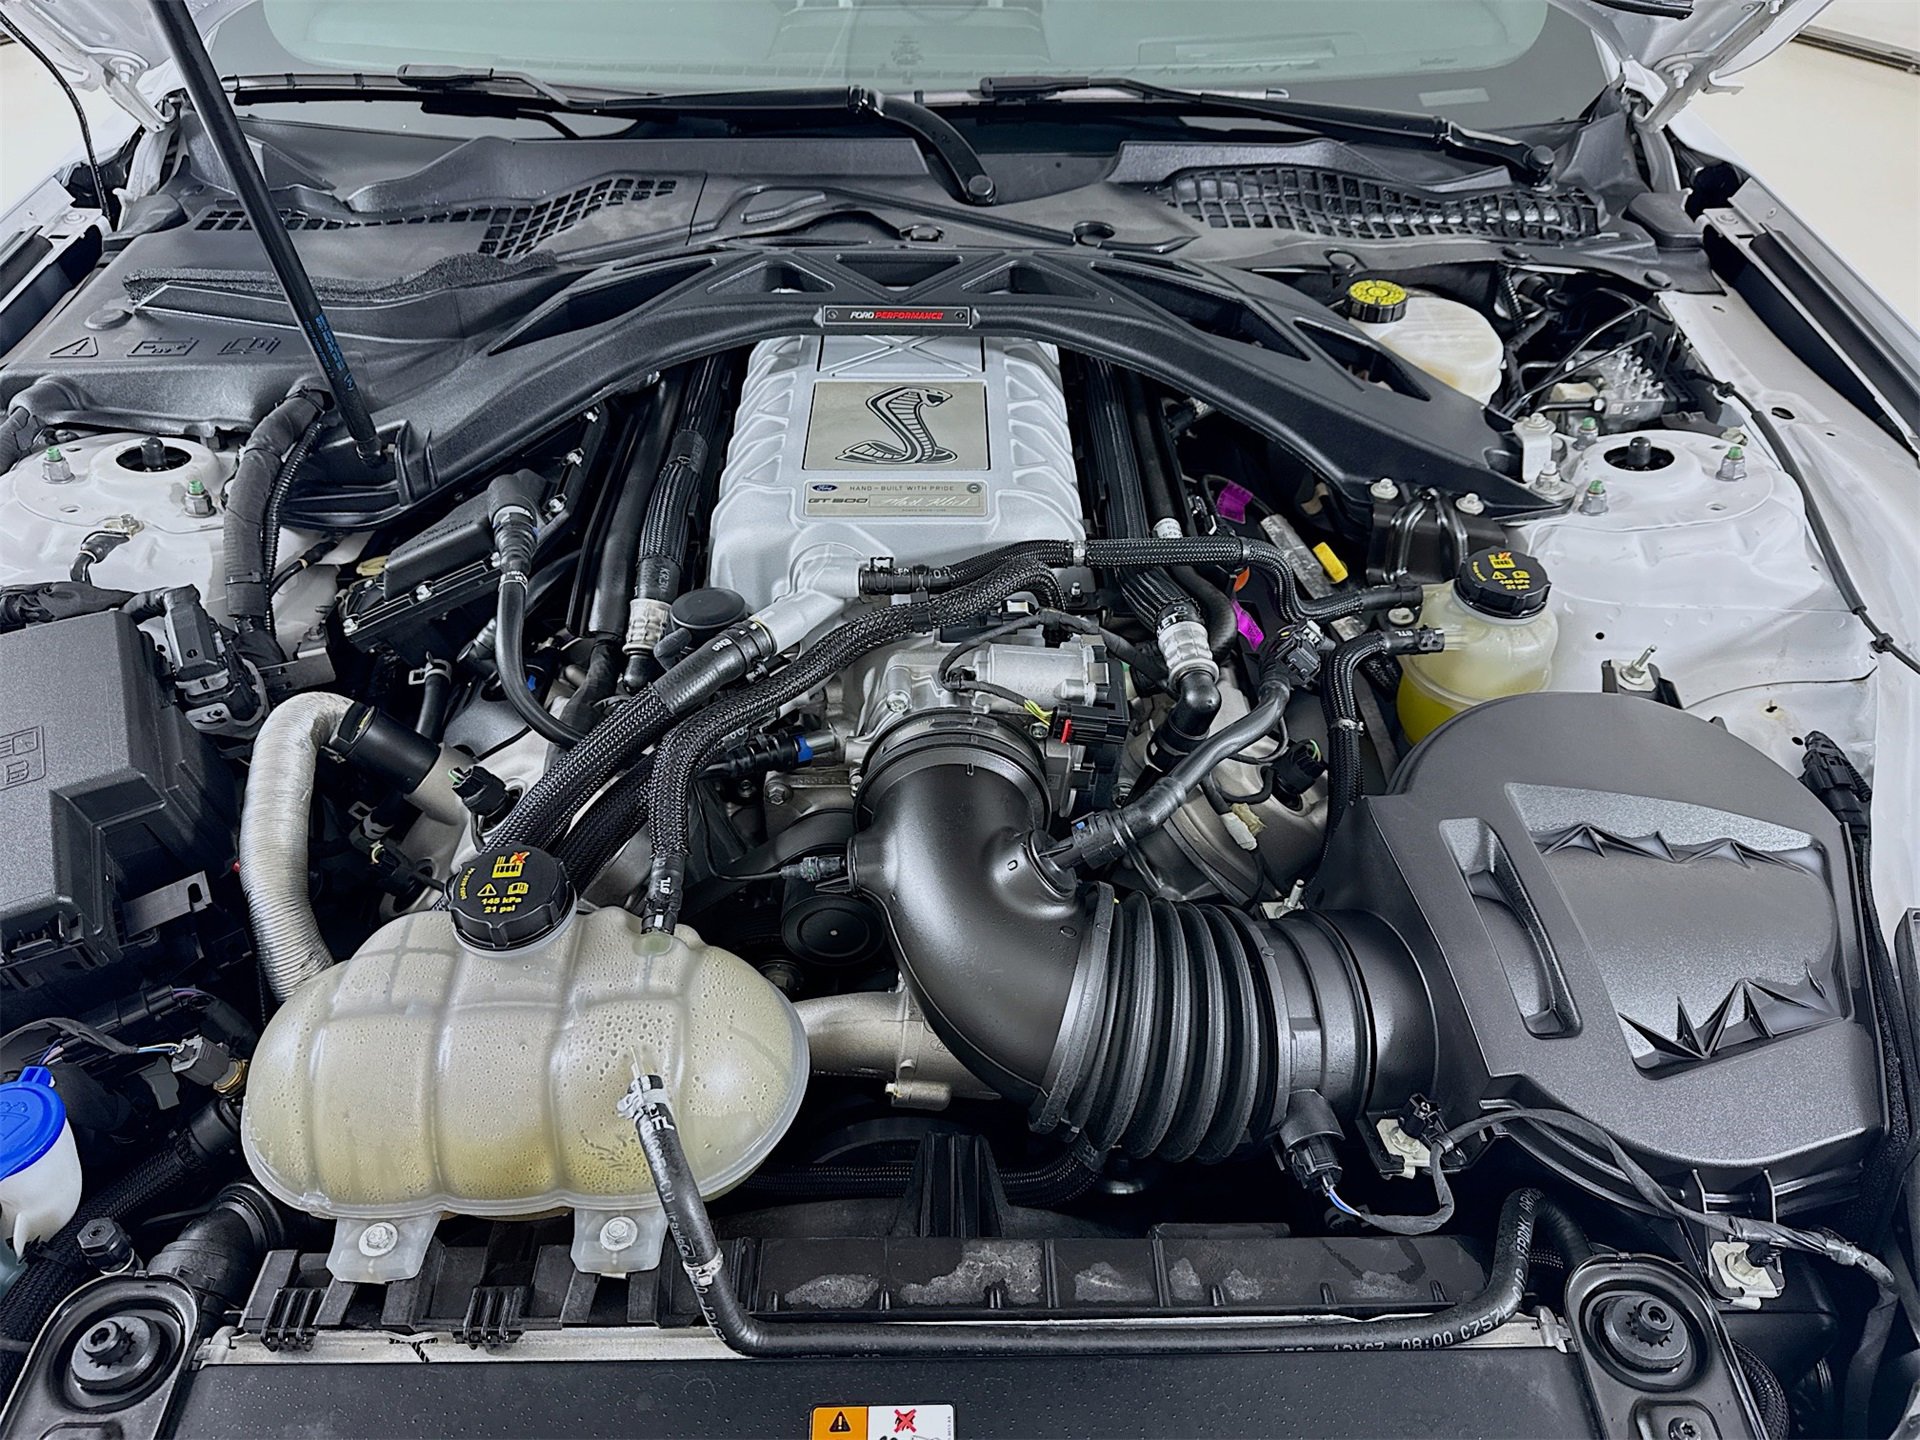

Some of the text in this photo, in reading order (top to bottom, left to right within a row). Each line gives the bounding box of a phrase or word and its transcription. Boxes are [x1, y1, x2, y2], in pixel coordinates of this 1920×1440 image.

[850, 311, 944, 320] FORD PERFORMANCE
[660, 876, 671, 894] BTL
[481, 896, 522, 905] 145 kPa
[483, 904, 516, 914] 21 psi
[1401, 1330, 1453, 1349] 08:00
[1460, 1305, 1512, 1340] C757L
